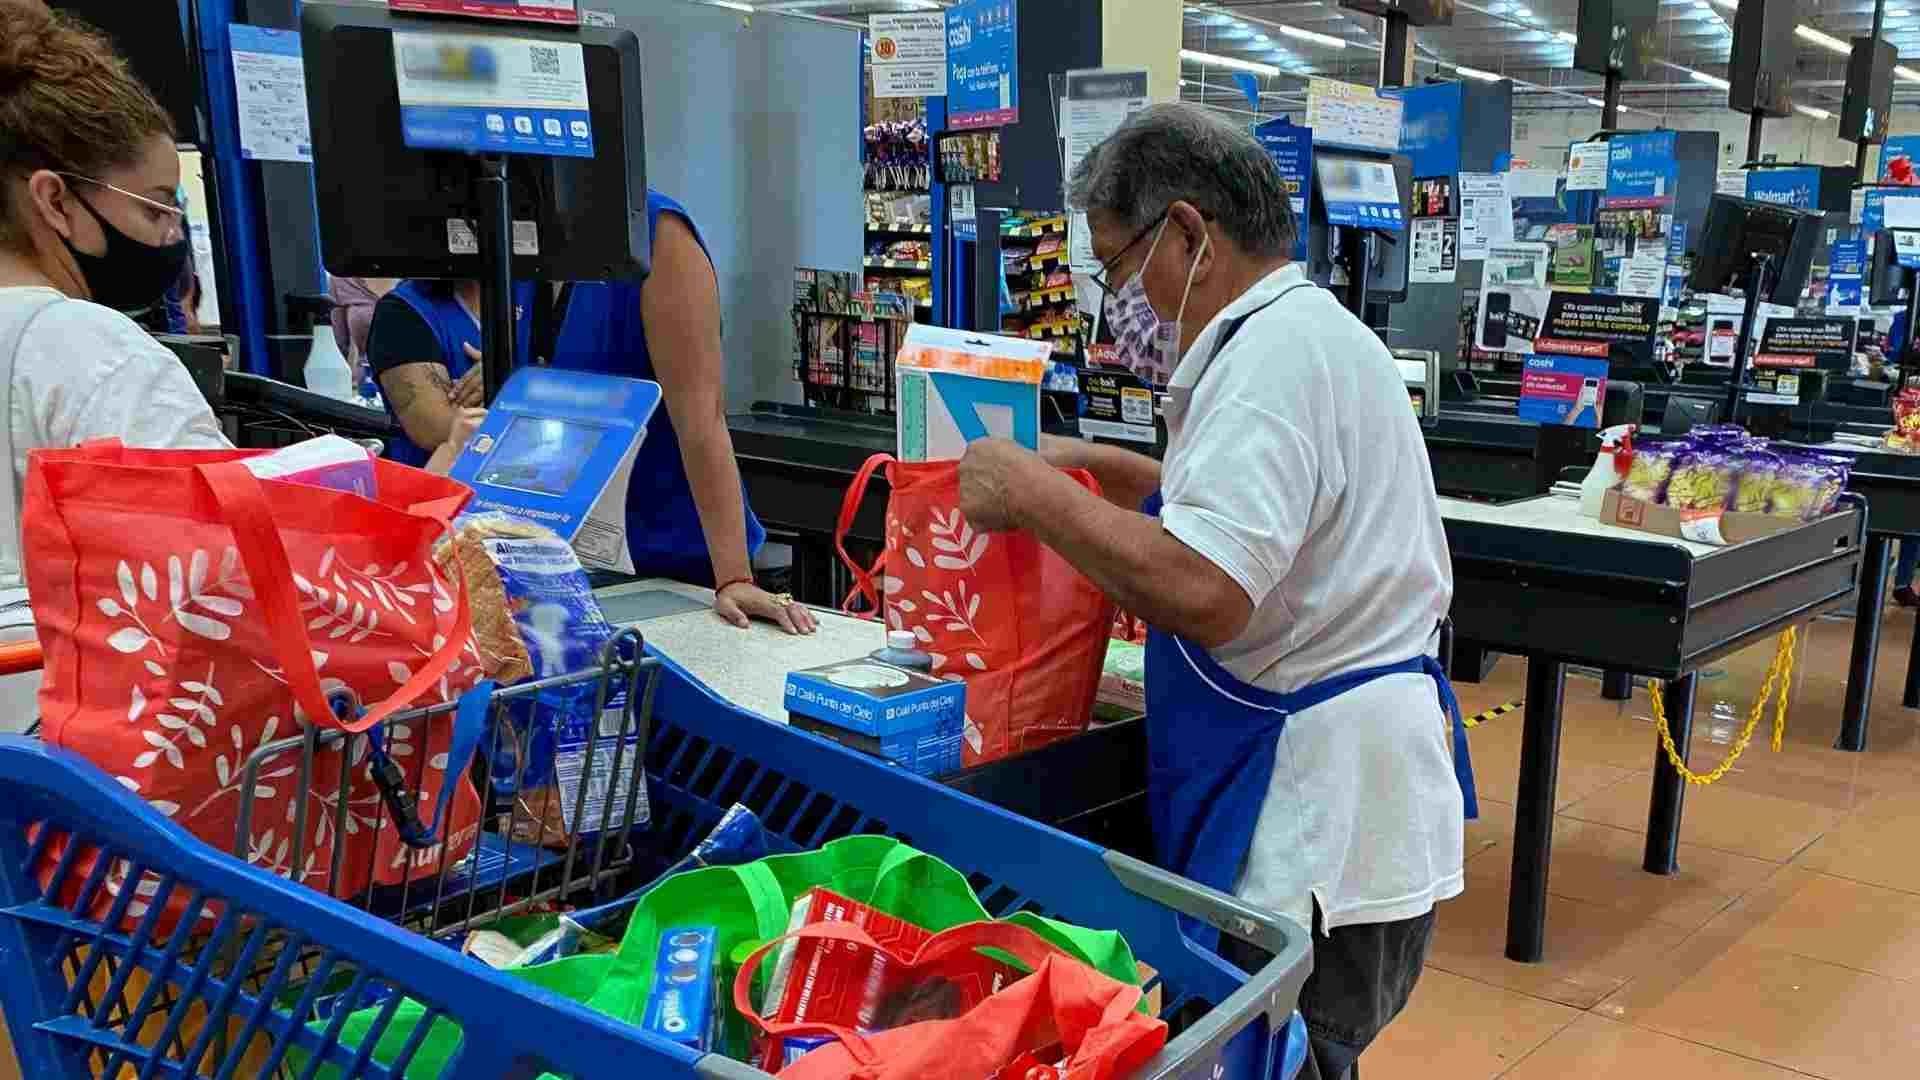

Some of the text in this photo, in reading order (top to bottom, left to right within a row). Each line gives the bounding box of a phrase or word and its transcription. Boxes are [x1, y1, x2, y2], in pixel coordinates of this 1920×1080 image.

[1753, 190, 1794, 204] Walmart
[1528, 359, 1554, 369] cashi
[797, 686, 873, 721] Café Punta del Cielo
